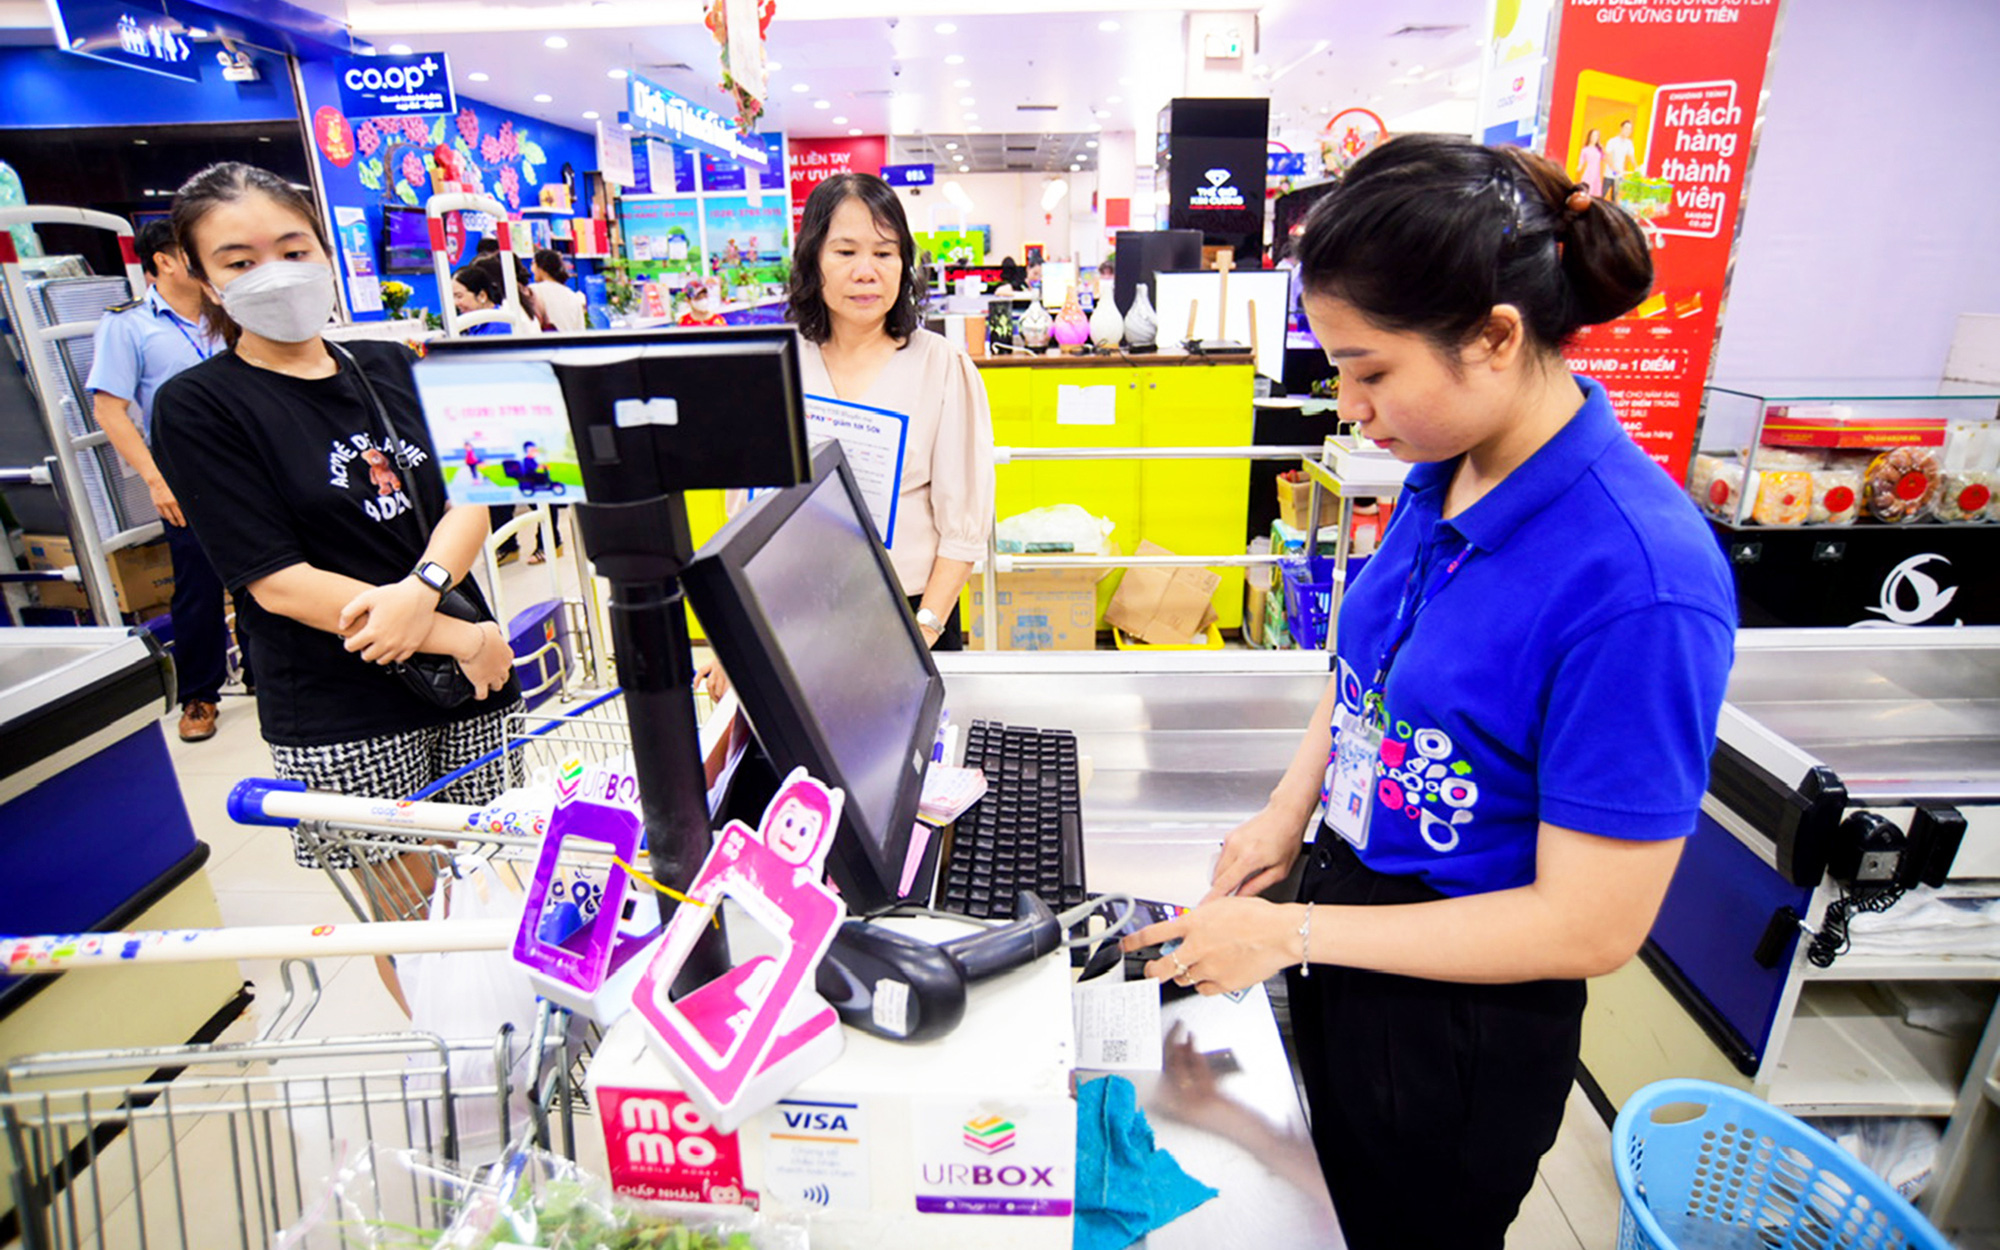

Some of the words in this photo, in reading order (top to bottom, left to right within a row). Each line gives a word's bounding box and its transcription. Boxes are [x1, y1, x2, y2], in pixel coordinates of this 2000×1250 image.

[1596, 8, 1625, 23] GIỮ
[1629, 7, 1672, 23] VỮNG
[1676, 9, 1702, 23] ƯU
[1704, 6, 1739, 23] TIÊN
[1665, 101, 1741, 127] khách
[1675, 128, 1737, 157] hàng
[829, 152, 851, 164] TAY
[1661, 158, 1731, 183] thành
[1676, 185, 1725, 209] viên
[1631, 358, 1638, 371] 1
[330, 441, 358, 489] ACMÉ
[783, 1111, 849, 1132] VISA
[923, 1163, 1055, 1188] URBOX
